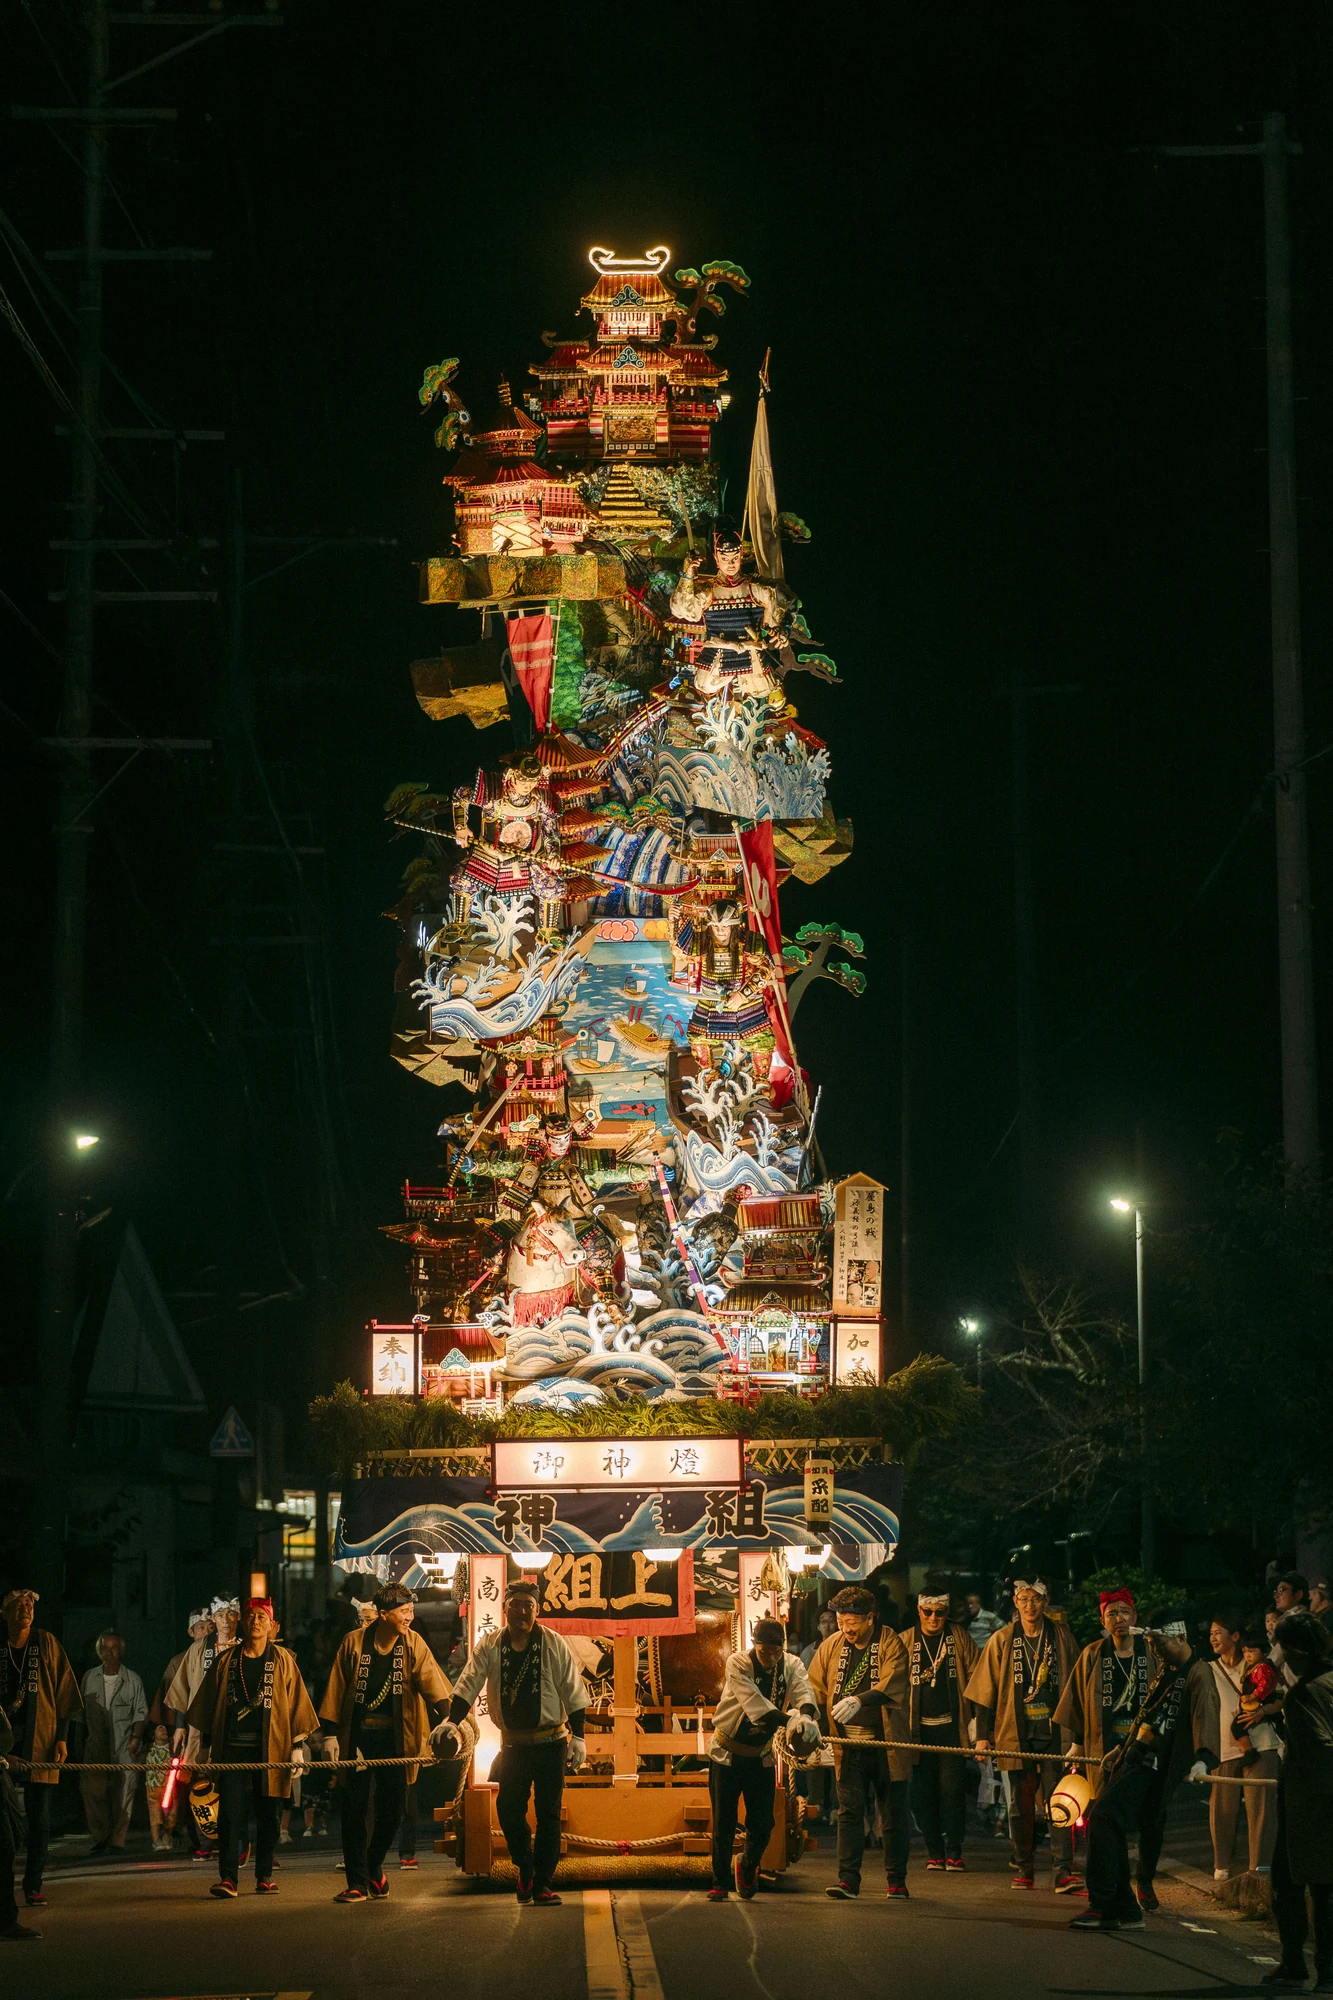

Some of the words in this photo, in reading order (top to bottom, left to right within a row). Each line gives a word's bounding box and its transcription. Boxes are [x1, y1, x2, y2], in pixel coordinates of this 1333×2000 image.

[378, 1336, 408, 1382] 奉納
[532, 1447, 701, 1479] 御神燈
